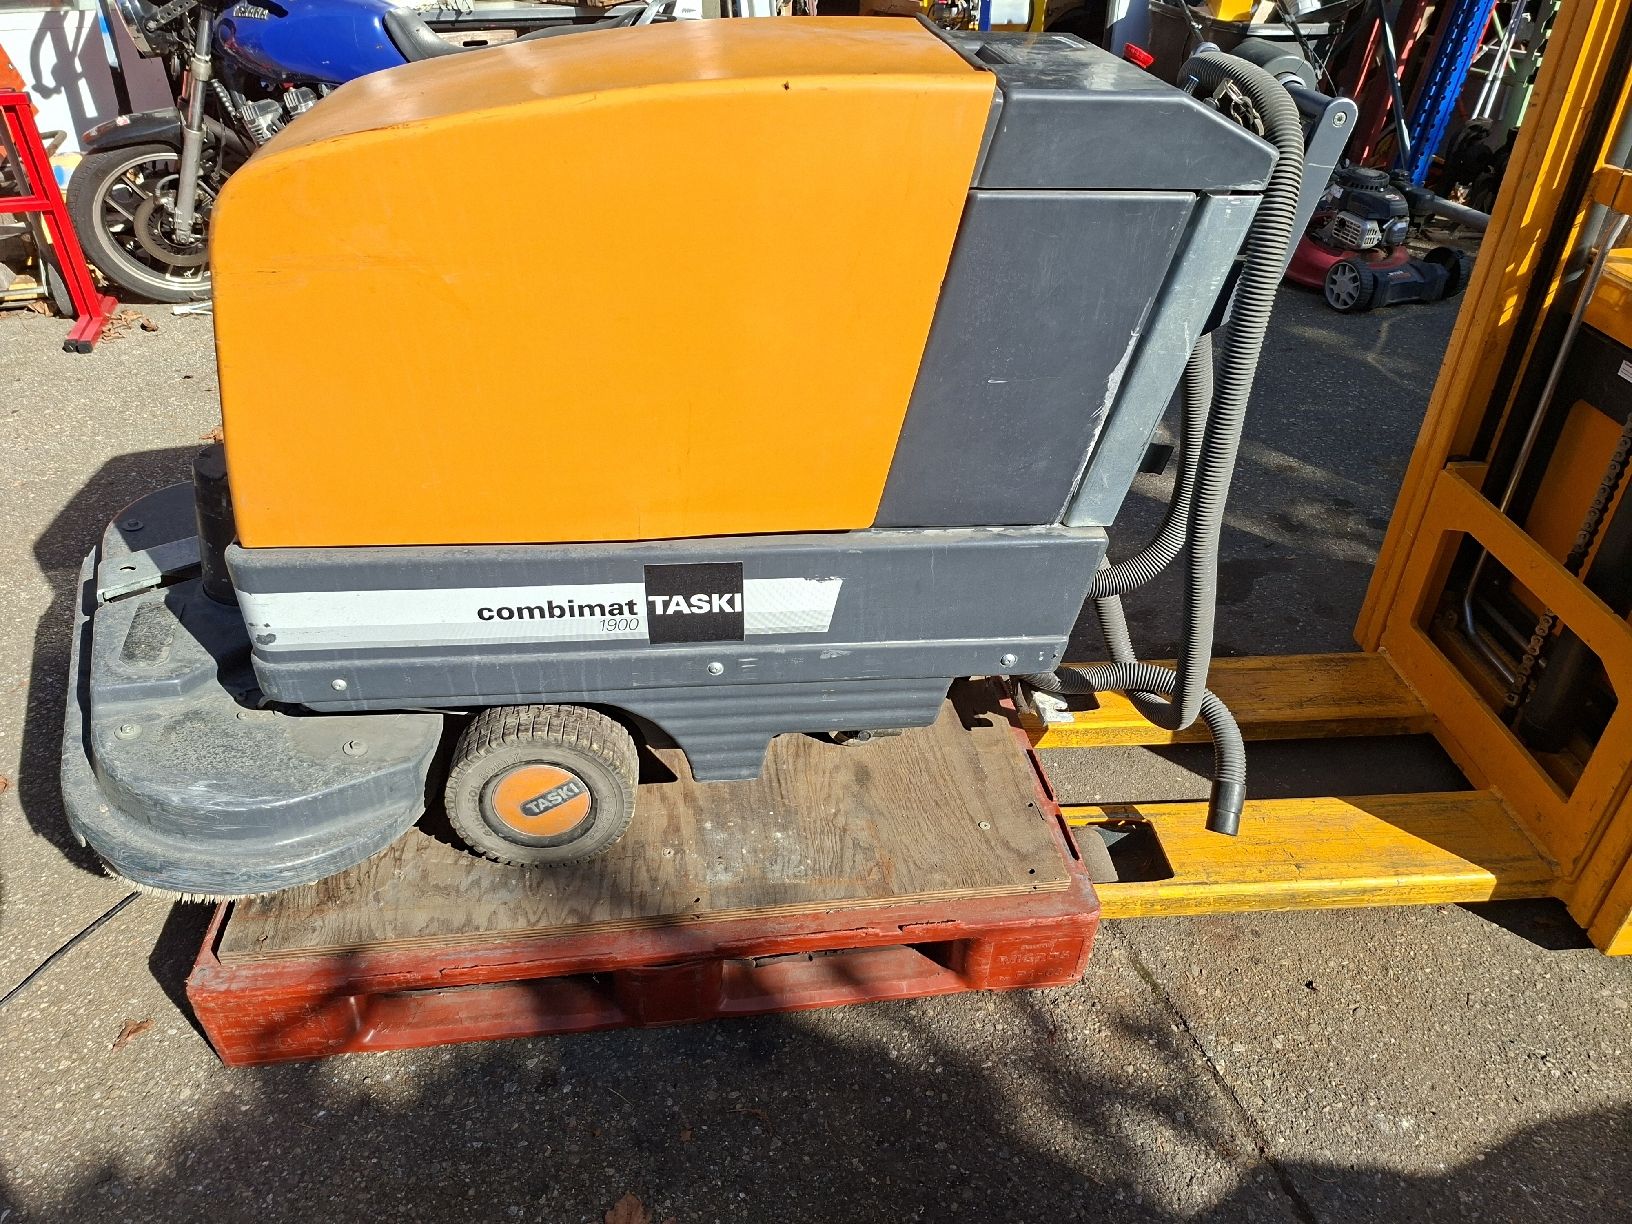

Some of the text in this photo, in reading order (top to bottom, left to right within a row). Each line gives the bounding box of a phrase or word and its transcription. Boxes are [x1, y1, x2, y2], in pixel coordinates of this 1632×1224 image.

[477, 599, 639, 621] combimat
[648, 592, 743, 615] TASKI
[600, 617, 640, 632] 1900
[525, 782, 580, 813] TASKI
